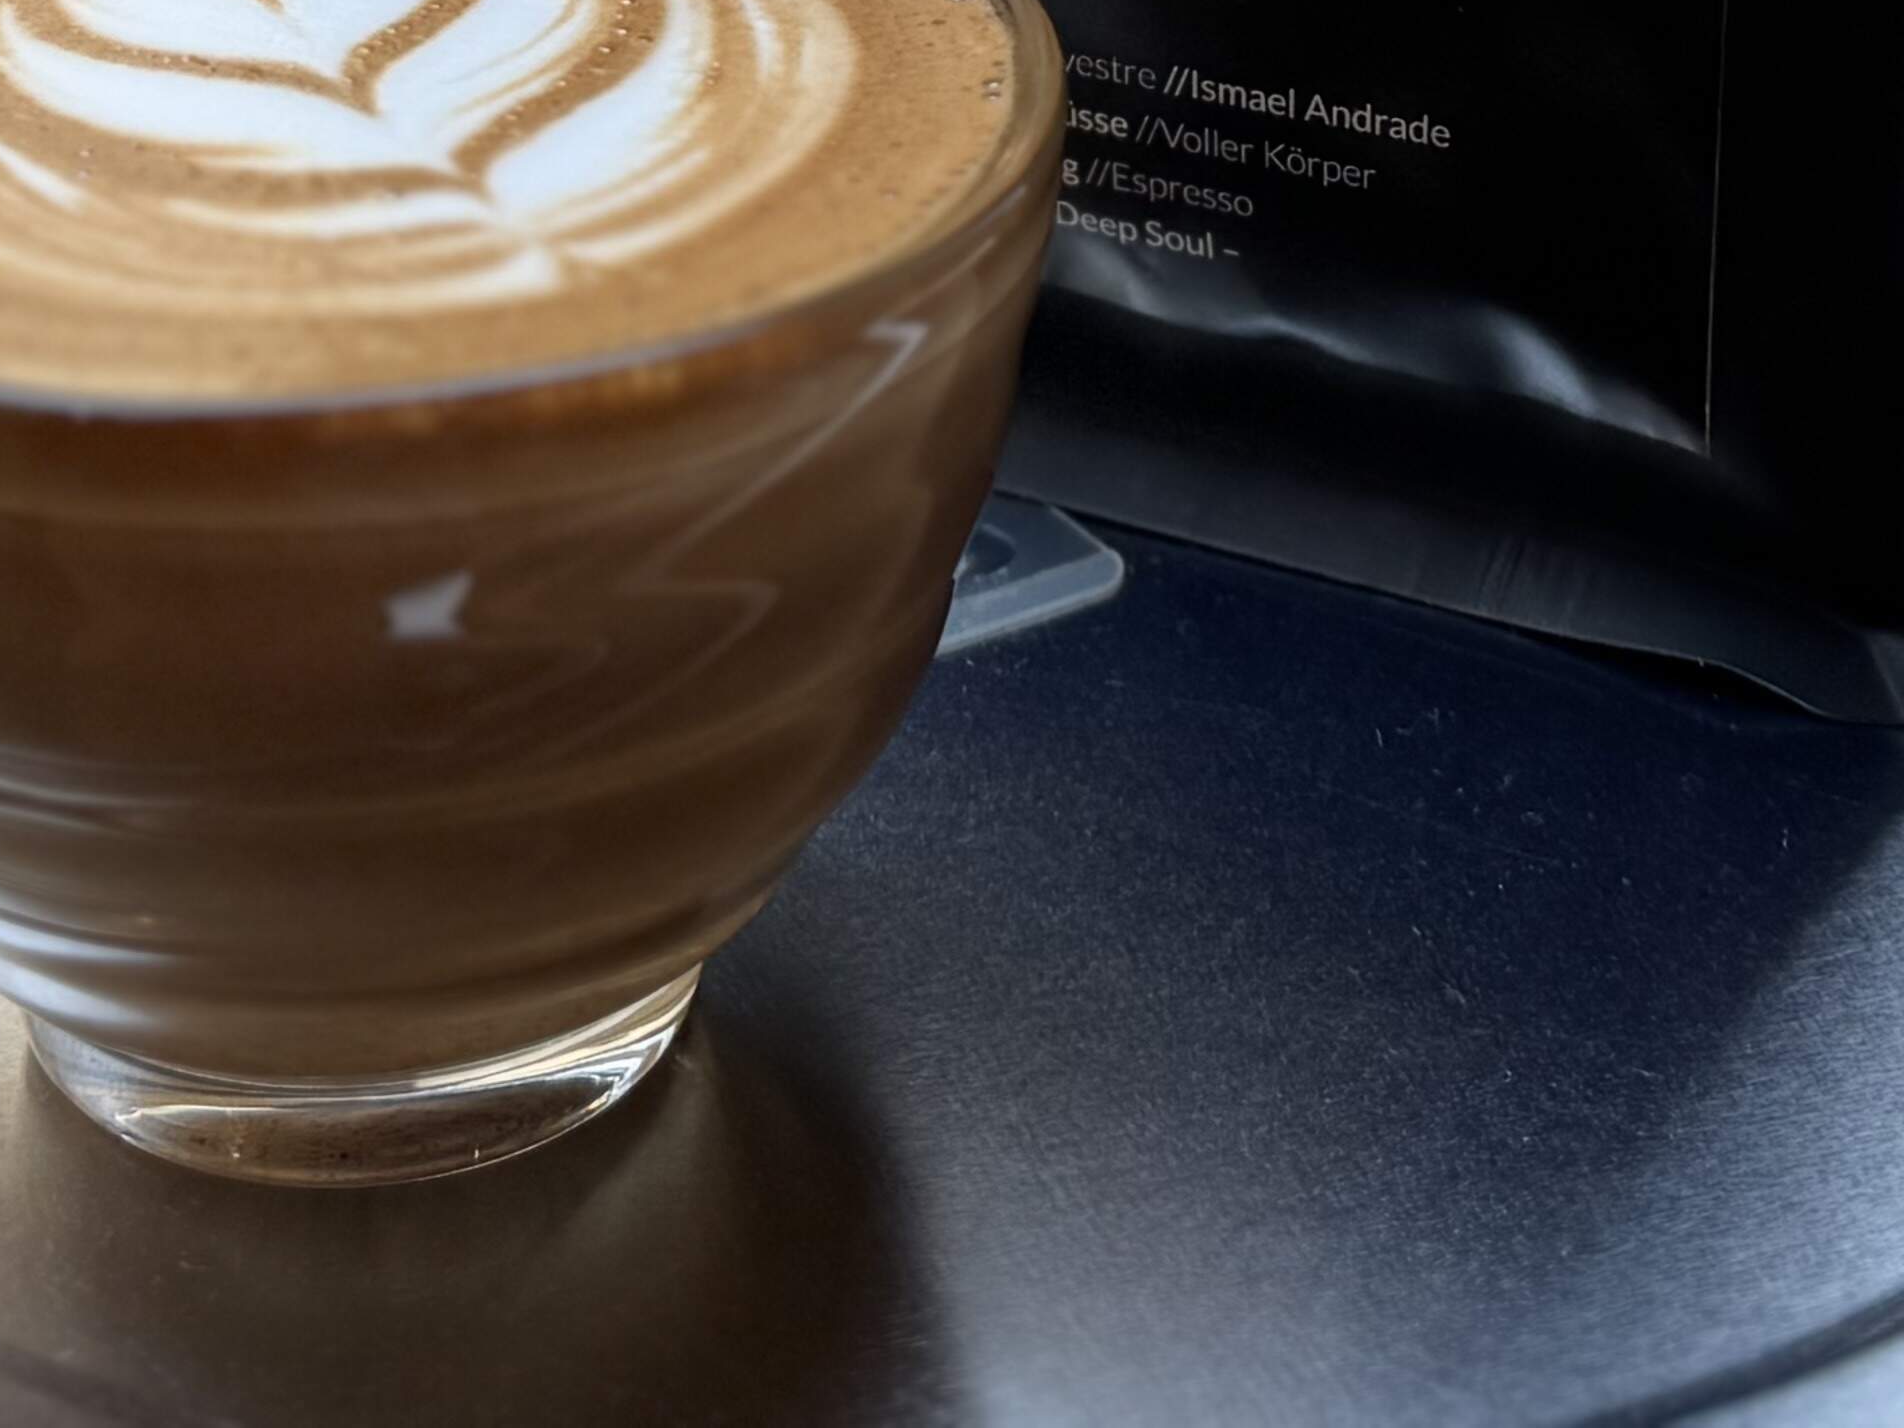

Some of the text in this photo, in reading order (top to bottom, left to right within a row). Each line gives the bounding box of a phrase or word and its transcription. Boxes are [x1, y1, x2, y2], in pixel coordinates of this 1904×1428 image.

[1304, 93, 1451, 148] Andrade
[1264, 140, 1376, 189] Körper
[1056, 199, 1138, 245] Deep
[1145, 220, 1214, 260] Soul
